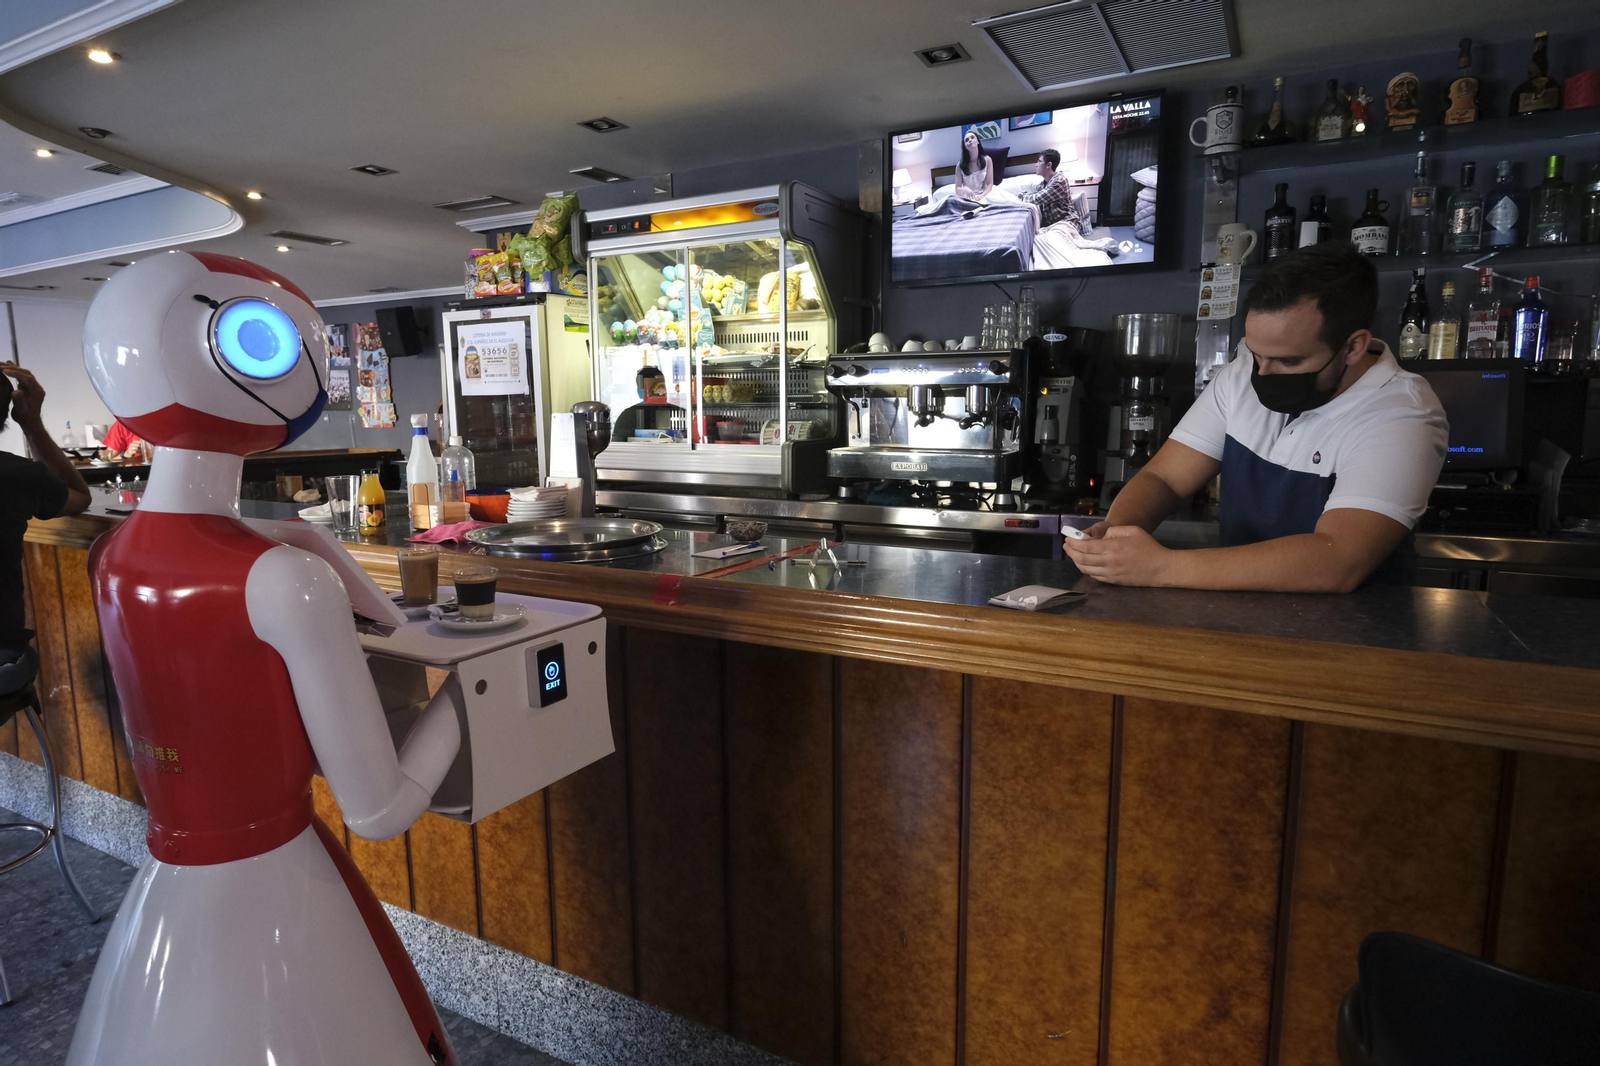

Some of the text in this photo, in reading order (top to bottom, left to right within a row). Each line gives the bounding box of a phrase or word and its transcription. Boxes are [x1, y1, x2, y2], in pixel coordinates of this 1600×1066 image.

[1110, 101, 1151, 114] LA VALLA
[1469, 325, 1497, 333] BEEFEATER
[481, 347, 508, 356] 53656
[1447, 445, 1484, 453] osoft.com
[545, 679, 561, 691] EXIT
[173, 766, 185, 774] ME
